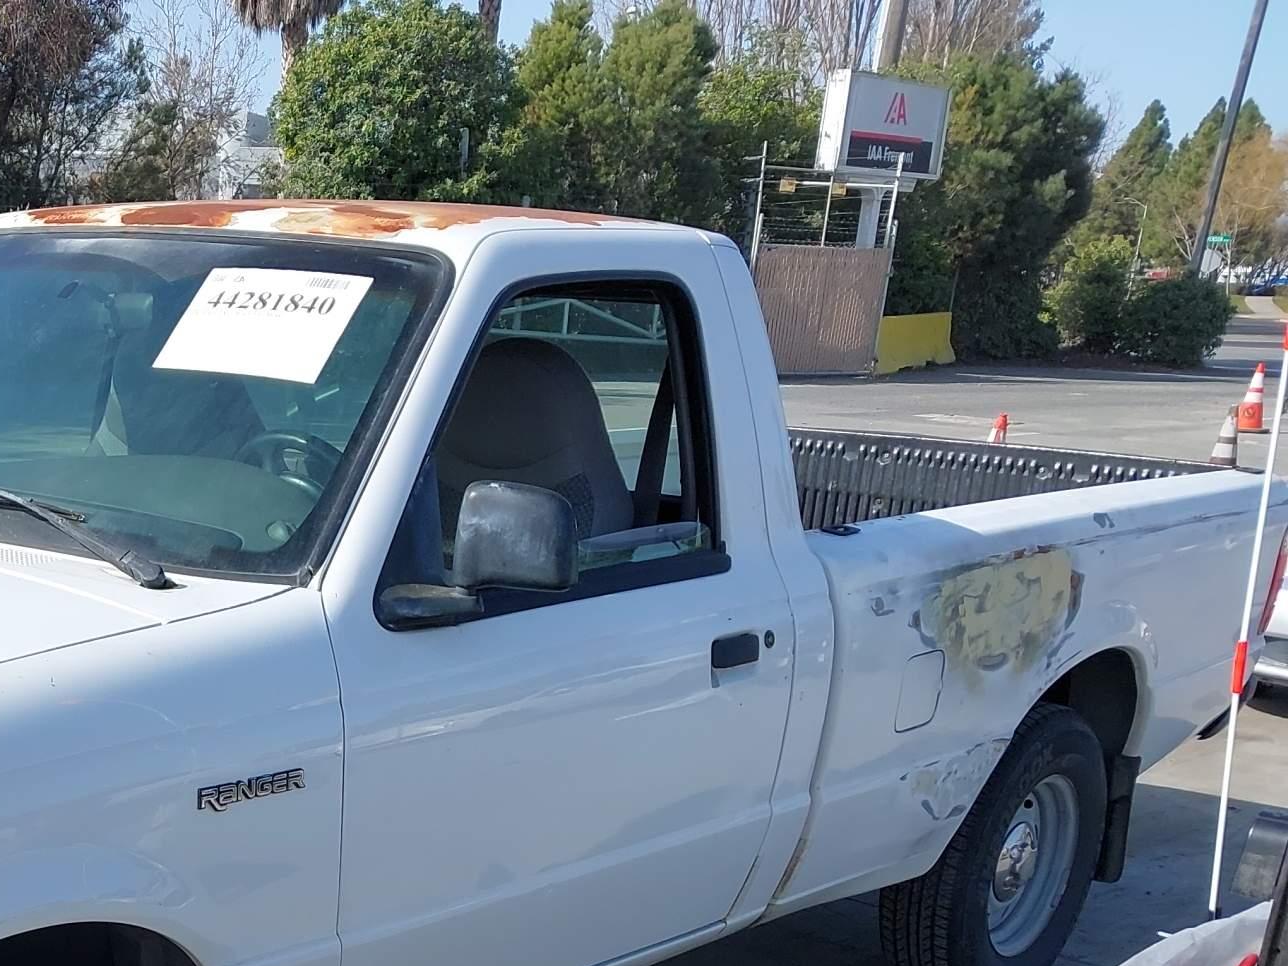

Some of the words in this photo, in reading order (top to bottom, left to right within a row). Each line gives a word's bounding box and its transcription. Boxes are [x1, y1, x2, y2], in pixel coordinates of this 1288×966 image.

[867, 144, 882, 161] IAA
[207, 290, 336, 315] 44281840
[197, 767, 306, 812] RANGER
